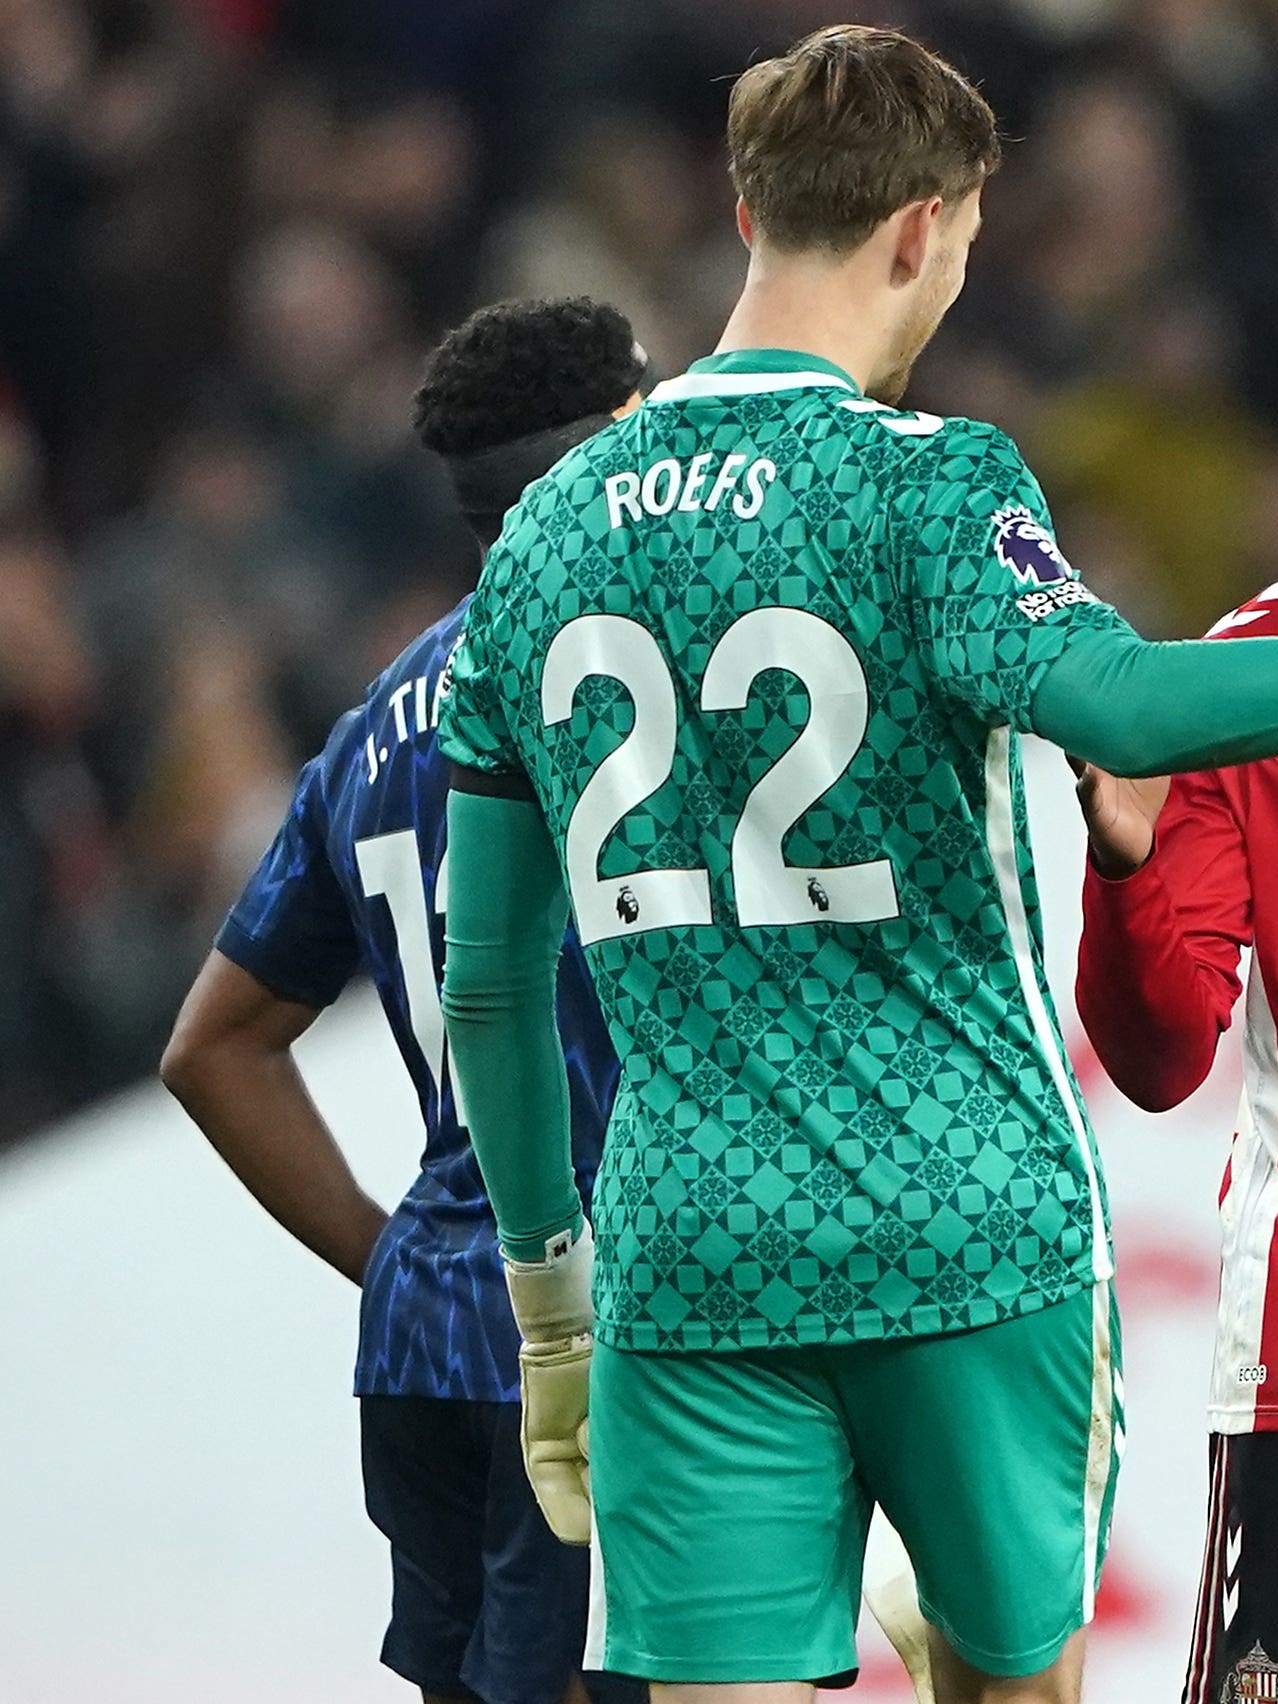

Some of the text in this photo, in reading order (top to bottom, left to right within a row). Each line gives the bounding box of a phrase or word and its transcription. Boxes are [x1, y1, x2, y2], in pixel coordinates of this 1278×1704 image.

[605, 452, 776, 529] ROEFS
[366, 732, 388, 785] J.
[541, 607, 899, 947] 22
